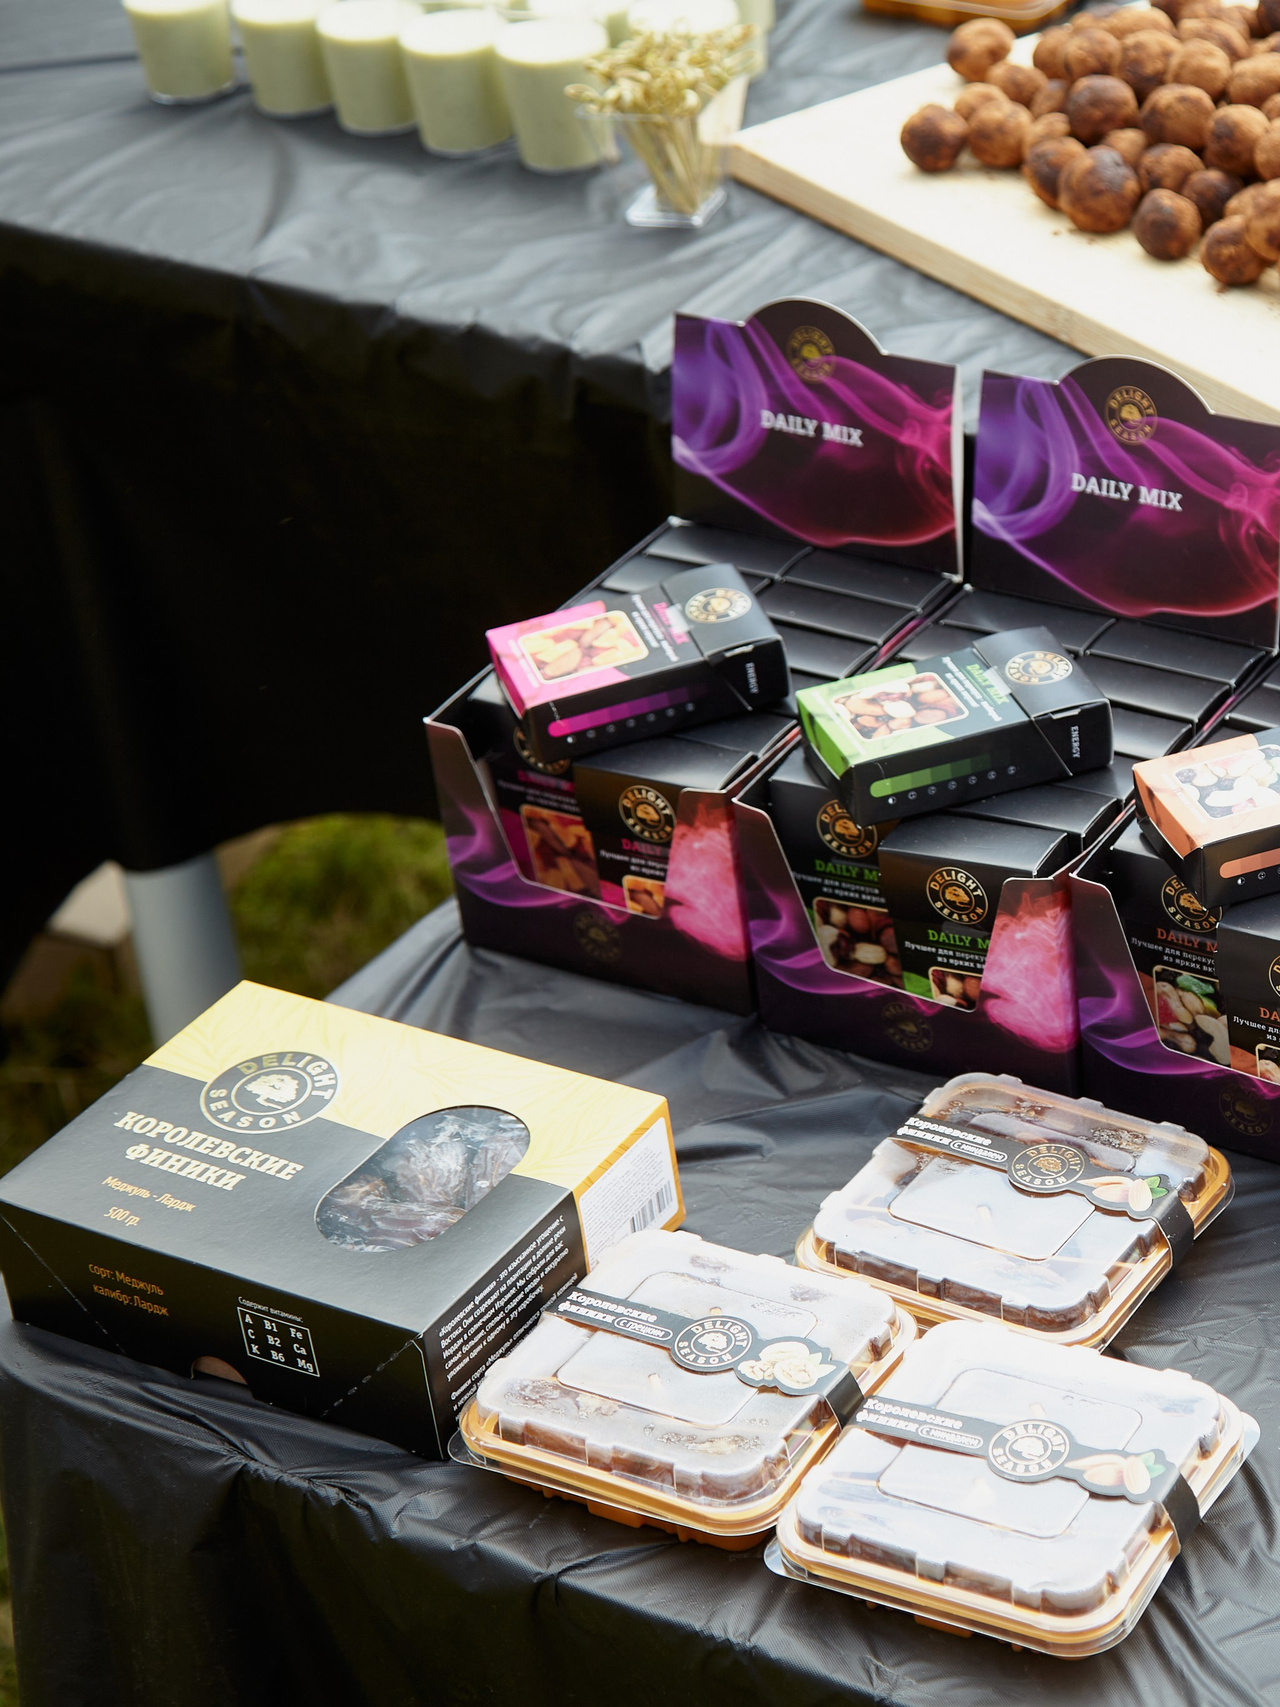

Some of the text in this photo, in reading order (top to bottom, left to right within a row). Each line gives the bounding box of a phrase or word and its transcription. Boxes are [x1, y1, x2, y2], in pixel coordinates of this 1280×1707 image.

[1110, 388, 1155, 416] DELIGHT
[760, 409, 864, 448] DAILY MIX
[1110, 418, 1153, 441] SEASON
[1071, 472, 1183, 512] DAILY MIX
[1071, 726, 1080, 758] ENERGY
[823, 833, 872, 855] SEASON
[814, 859, 858, 878] DAILY
[930, 870, 983, 896] DELIGHT
[934, 901, 984, 922] SEASON
[1168, 906, 1217, 930] SEASON
[928, 929, 972, 947] DAILY
[1131, 937, 1215, 966] Лучшее для перекус
[1156, 927, 1200, 948] DAILY
[1163, 955, 1174, 963] из
[1175, 958, 1201, 970] ярких
[1233, 1015, 1267, 1030] Лучшее
[1266, 1033, 1277, 1042] из
[237, 1053, 336, 1100] DELIGHT
[209, 1088, 301, 1128] SEASON
[896, 1125, 952, 1146] финики
[960, 1143, 1004, 1162] миндалем
[905, 1116, 993, 1146] Королевские
[113, 1111, 304, 1181] КОРОЛЕВСКИЕ
[1026, 1144, 1081, 1173] DELIGHT
[125, 1143, 247, 1191] ФИНИКИ
[1015, 1163, 1067, 1185] SEASON
[102, 1175, 197, 1213] Меджуль Лардж
[104, 1206, 141, 1227] 500 гр.
[88, 1263, 164, 1296] сорт: Меджуль
[92, 1283, 170, 1317] калибр: Лардж
[238, 1296, 269, 1312] Содержит
[566, 1291, 658, 1323] Королевские
[244, 1313, 303, 1340] A B1 Fe
[557, 1300, 617, 1324] финики
[625, 1320, 666, 1338] грецким
[247, 1329, 307, 1355] C B2 Ca
[690, 1320, 747, 1348] DELIGHT
[250, 1343, 314, 1373] K B6 Mg
[678, 1340, 733, 1365] SEASON
[855, 1409, 920, 1433] финики
[863, 1398, 963, 1430] Королевские
[1003, 1423, 1065, 1453] DELIGHT
[993, 1447, 1053, 1473] SEASON
